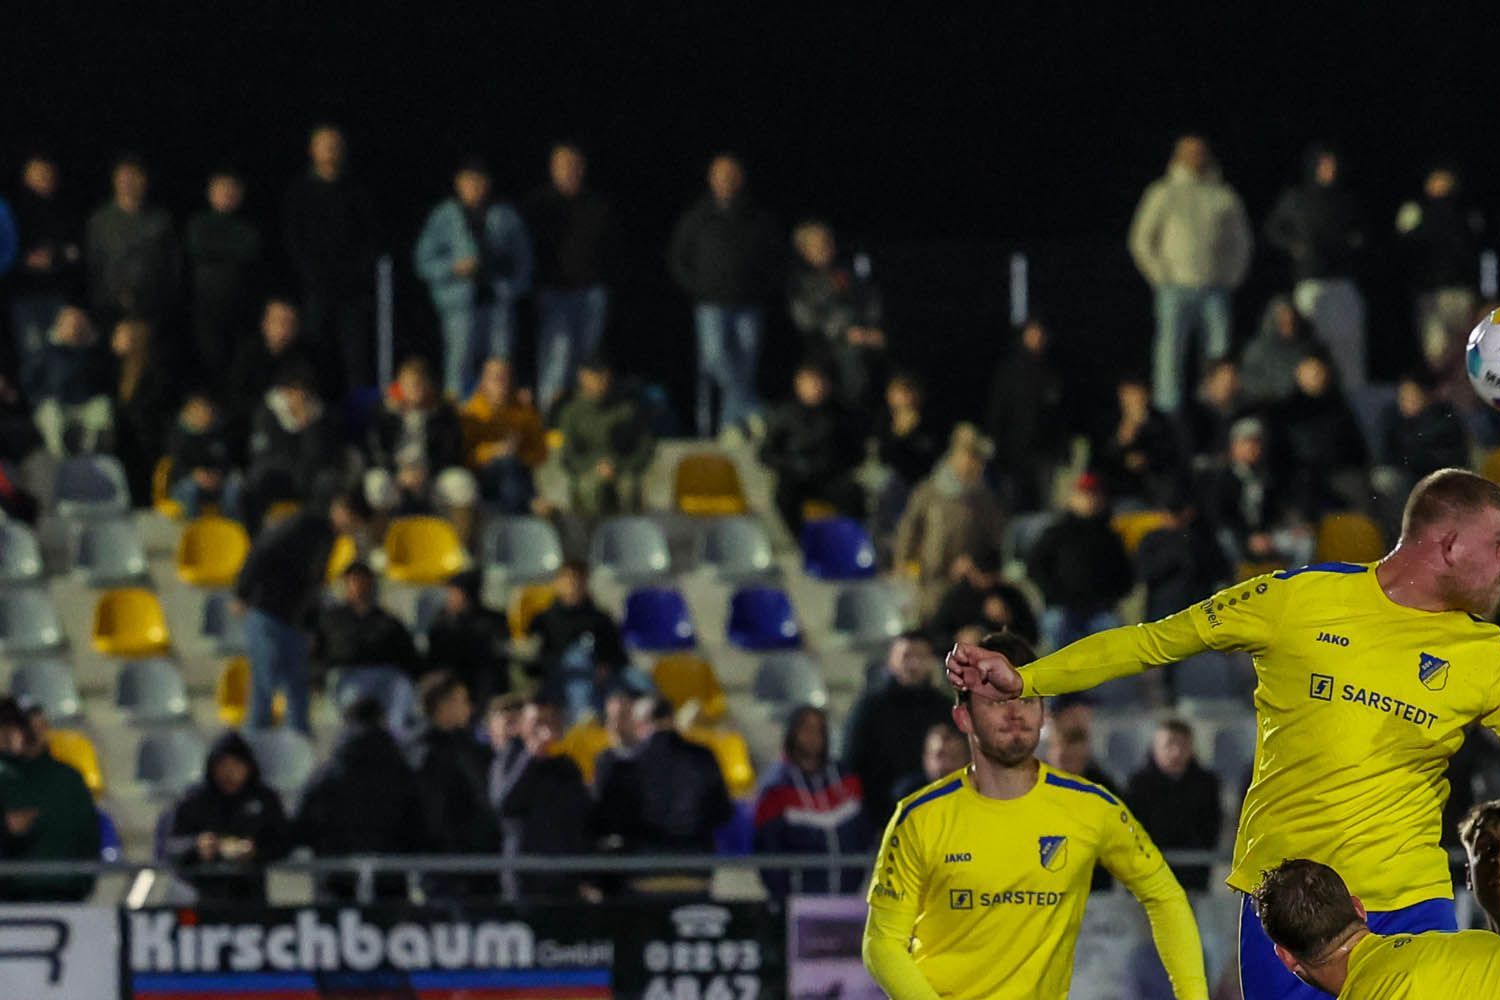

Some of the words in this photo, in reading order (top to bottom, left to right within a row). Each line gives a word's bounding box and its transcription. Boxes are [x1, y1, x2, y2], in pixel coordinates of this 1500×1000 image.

[1316, 632, 1350, 647] JAKO
[1341, 684, 1438, 729] SARSTEDT
[944, 852, 972, 864] JAKO
[980, 891, 1066, 907] SARSTEDT
[130, 908, 534, 970] Kirschbaum
